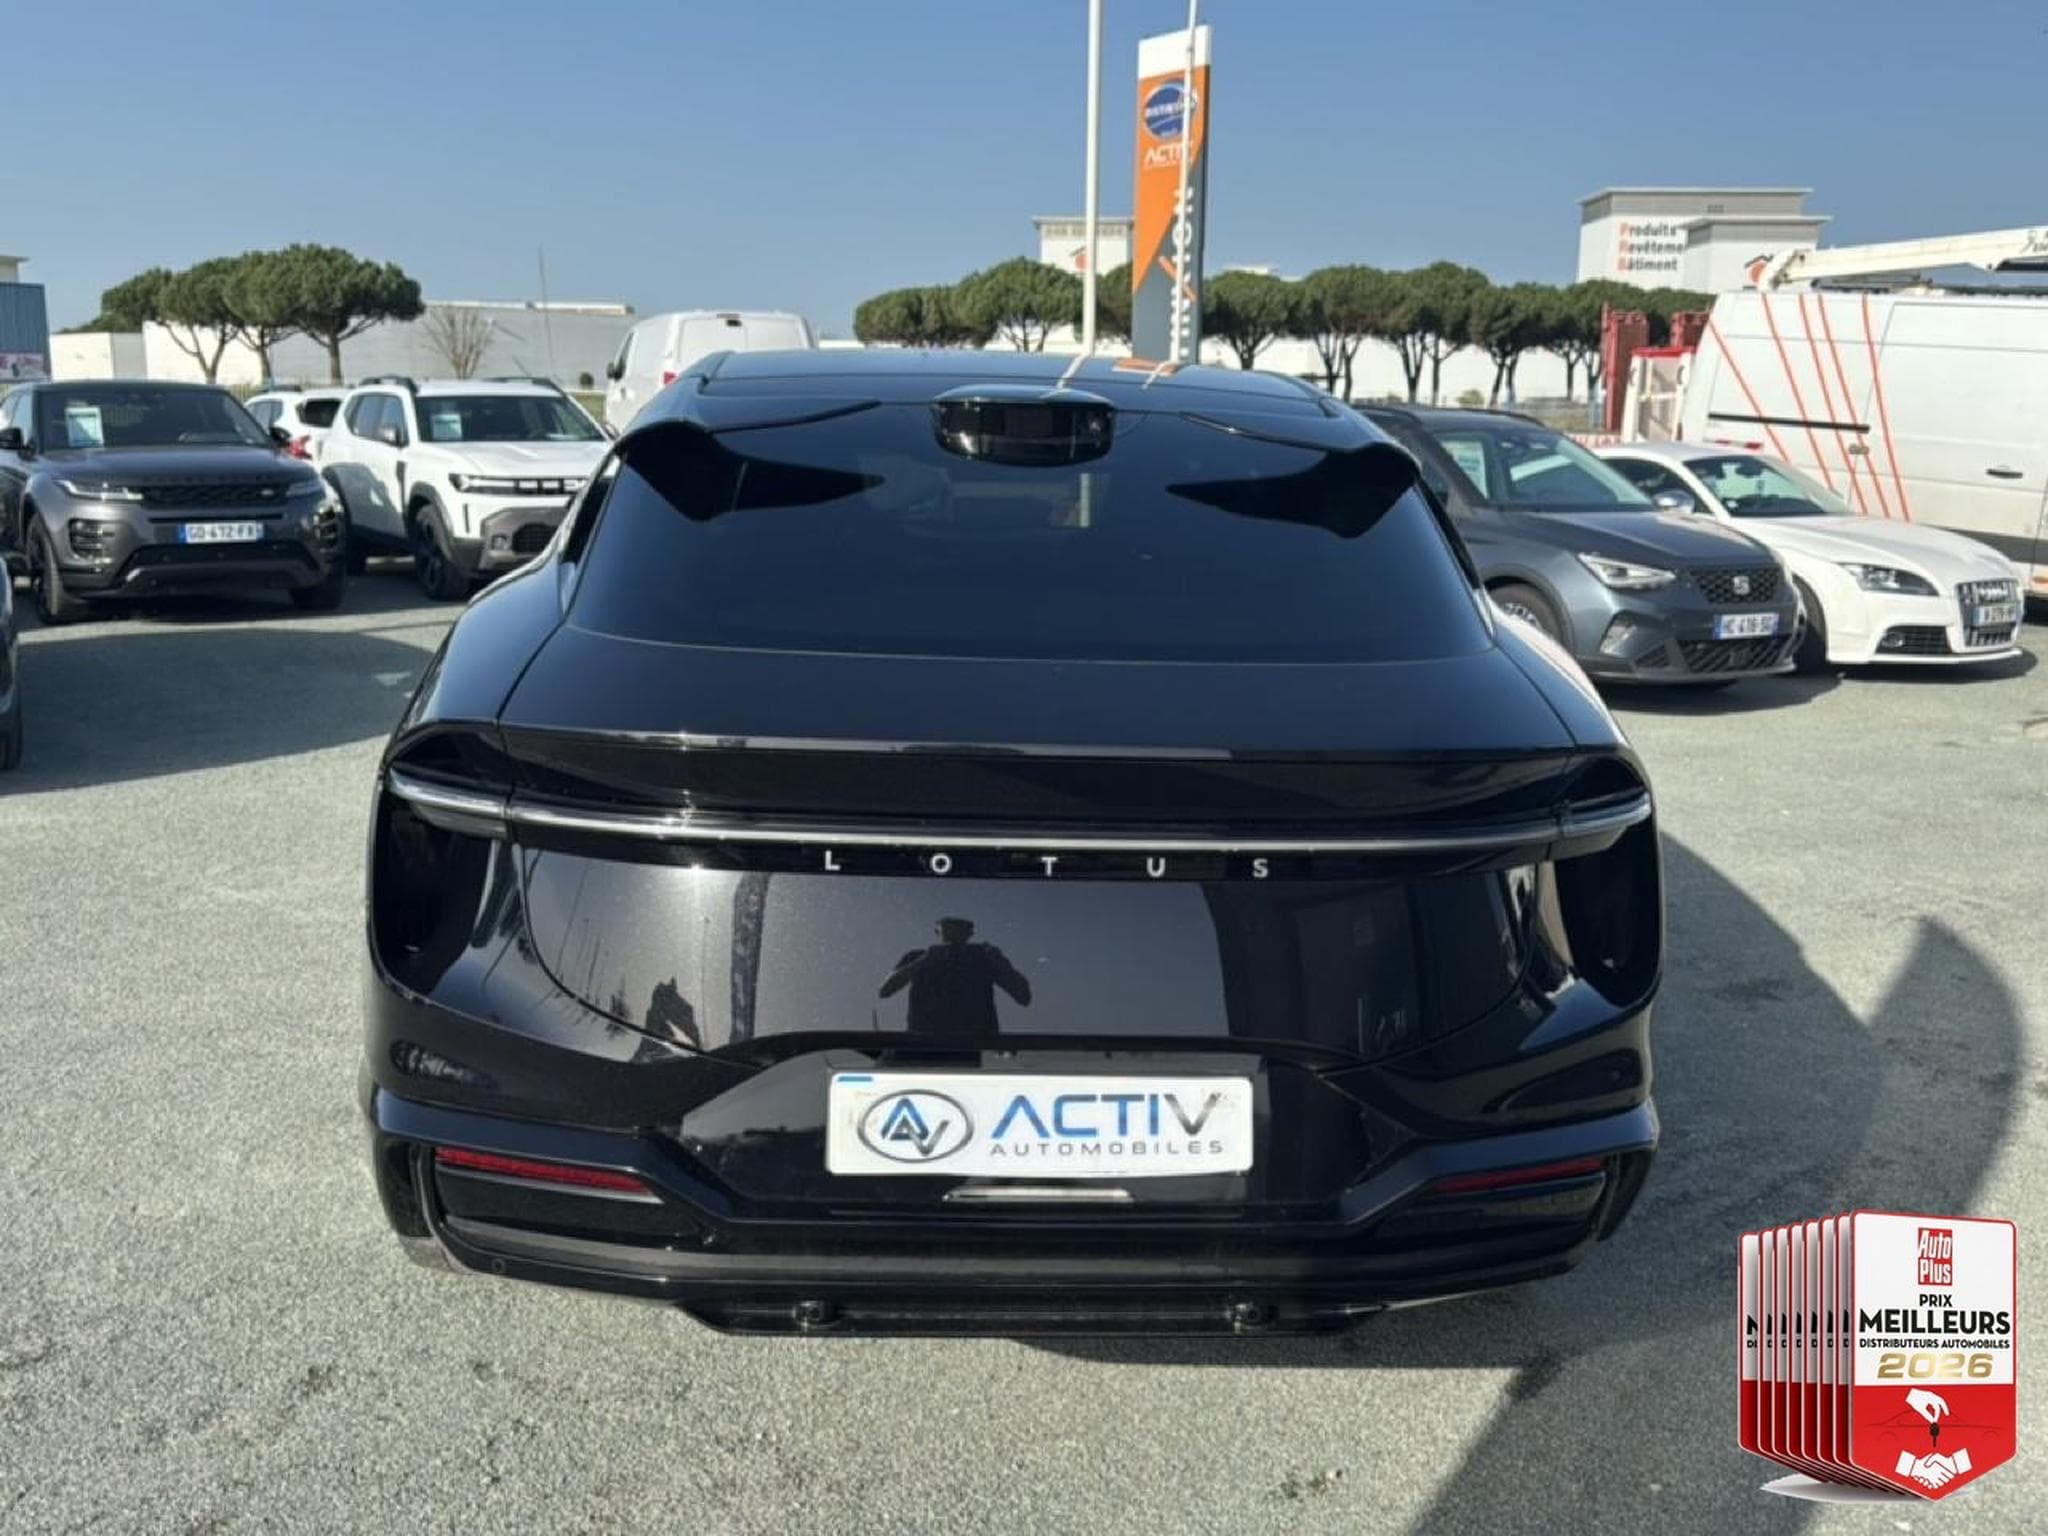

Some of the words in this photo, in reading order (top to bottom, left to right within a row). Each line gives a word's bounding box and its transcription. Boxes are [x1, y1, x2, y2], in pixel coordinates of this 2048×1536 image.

[1619, 222, 1677, 237] Produits
[1618, 258, 1678, 271] Bâtiment
[825, 850, 1269, 879] LOTUS
[990, 1092, 1226, 1139] ACTIV
[989, 1139, 1224, 1157] AUTOMOBILES
